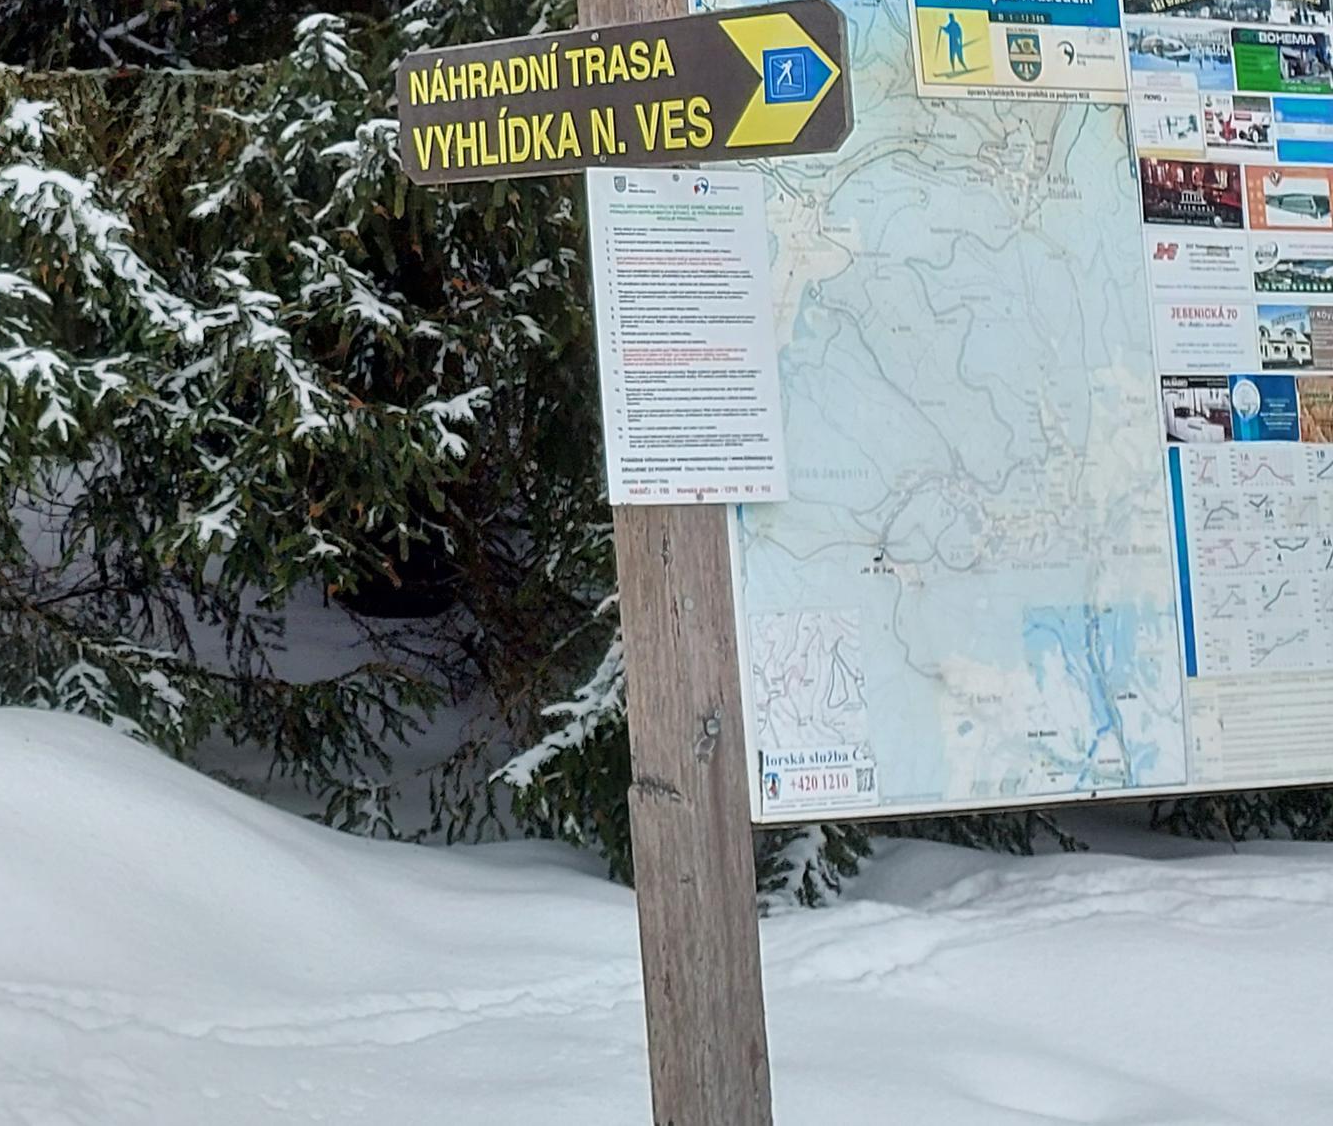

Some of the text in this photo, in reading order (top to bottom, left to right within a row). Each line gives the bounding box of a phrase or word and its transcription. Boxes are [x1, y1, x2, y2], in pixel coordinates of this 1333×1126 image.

[1259, 32, 1316, 46] BOHEMIA
[409, 37, 675, 107] NÁHRADNÍ TRASA
[412, 95, 713, 172] VYHLÍDKA N. VES
[1171, 306, 1238, 319] JESENICKÁ 70
[809, 748, 849, 763] služba
[822, 773, 849, 791] 1210
